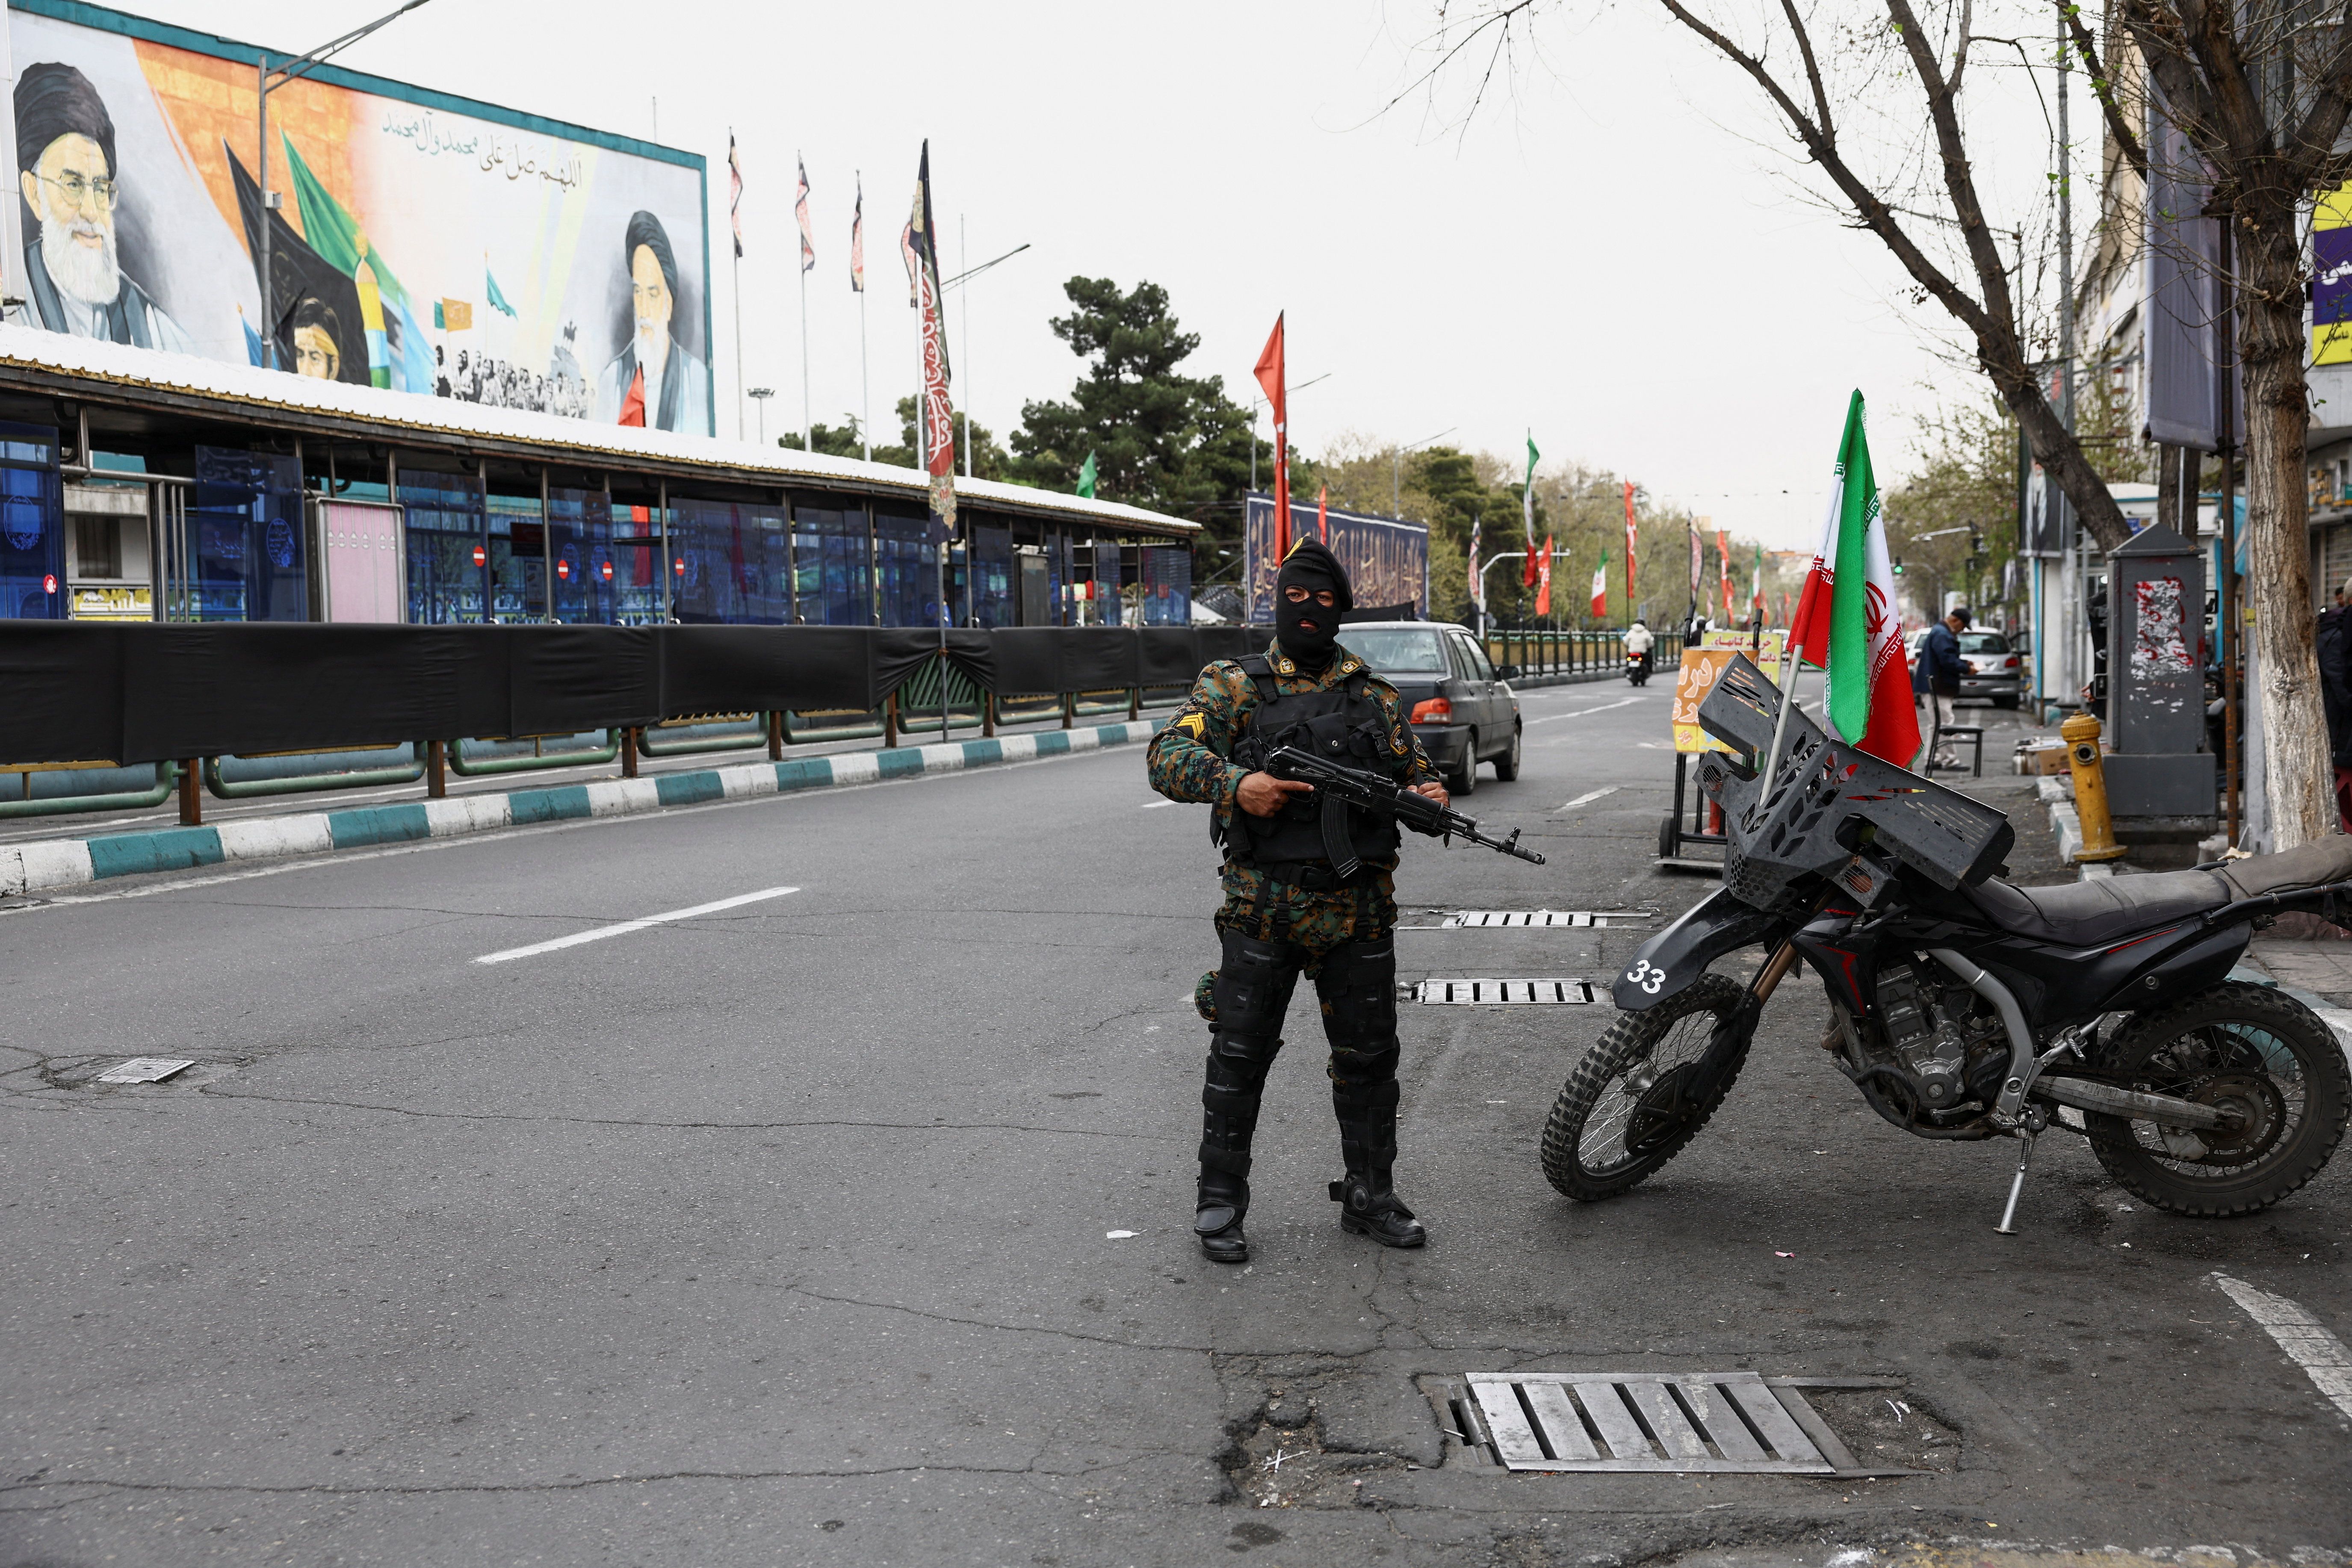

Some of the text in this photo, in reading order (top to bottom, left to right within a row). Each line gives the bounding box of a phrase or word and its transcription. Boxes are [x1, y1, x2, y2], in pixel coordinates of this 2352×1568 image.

[383, 113, 419, 137] محمد
[442, 130, 478, 155] محمد
[1627, 960, 1666, 994] 33
